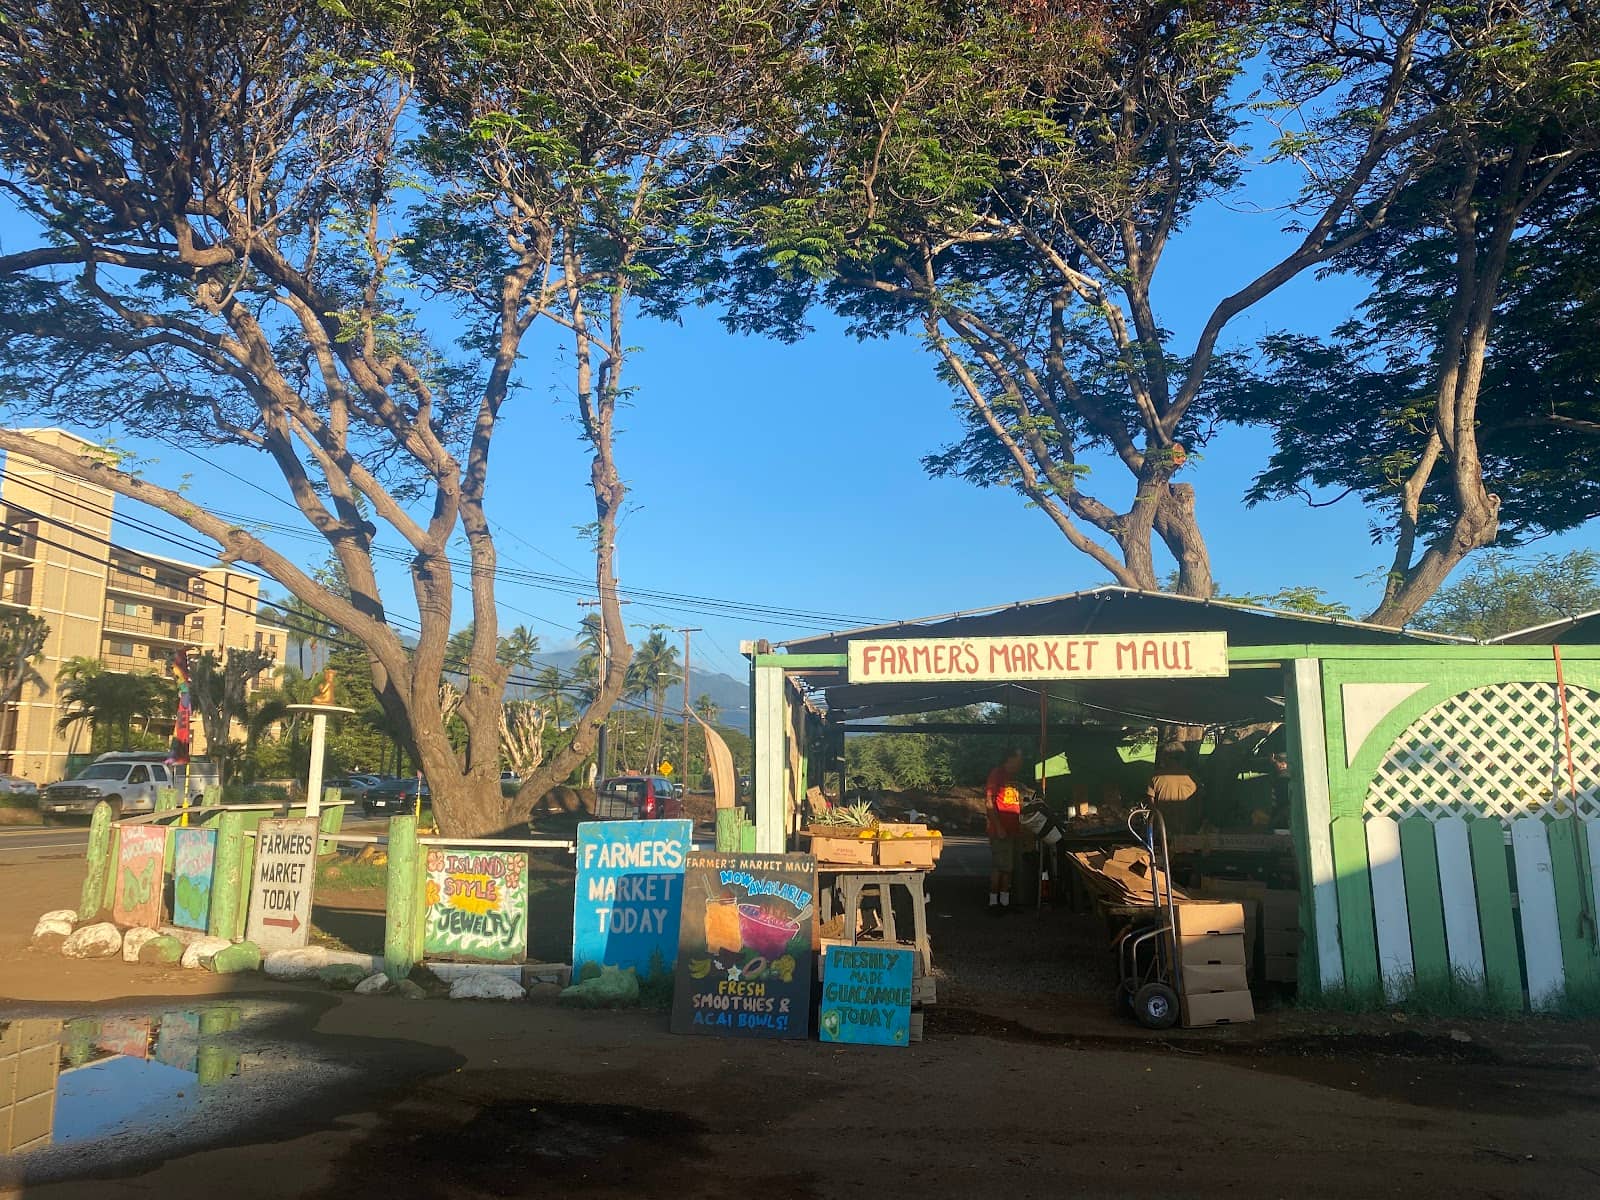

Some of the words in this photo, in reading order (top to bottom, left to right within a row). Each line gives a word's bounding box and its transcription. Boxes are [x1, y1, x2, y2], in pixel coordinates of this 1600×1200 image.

[863, 642, 979, 675] FARMER'S
[989, 641, 1099, 673] MARKET
[1115, 640, 1194, 670] MAUI
[260, 833, 312, 855] FARMERS
[584, 838, 682, 869] FARMER'S
[261, 862, 306, 884] MARKET
[445, 855, 506, 878] ISLAND
[686, 857, 736, 869] FARMER'S
[740, 859, 782, 872] MARKET
[444, 877, 497, 900] STYLE
[588, 874, 677, 901] MARKET
[720, 870, 754, 888] NOW
[263, 889, 300, 911] TODAY
[436, 908, 521, 946] JEWELRY
[595, 908, 667, 935] TODAY
[833, 950, 900, 970] FRESHLY
[850, 971, 883, 984] MADE
[718, 981, 765, 997] FRESH
[692, 993, 775, 1013] SMOOTHIES
[779, 998, 790, 1013] &
[693, 1010, 732, 1028] ACAI
[738, 1012, 789, 1031] BOWLS!
[837, 1006, 896, 1030] TODAY
